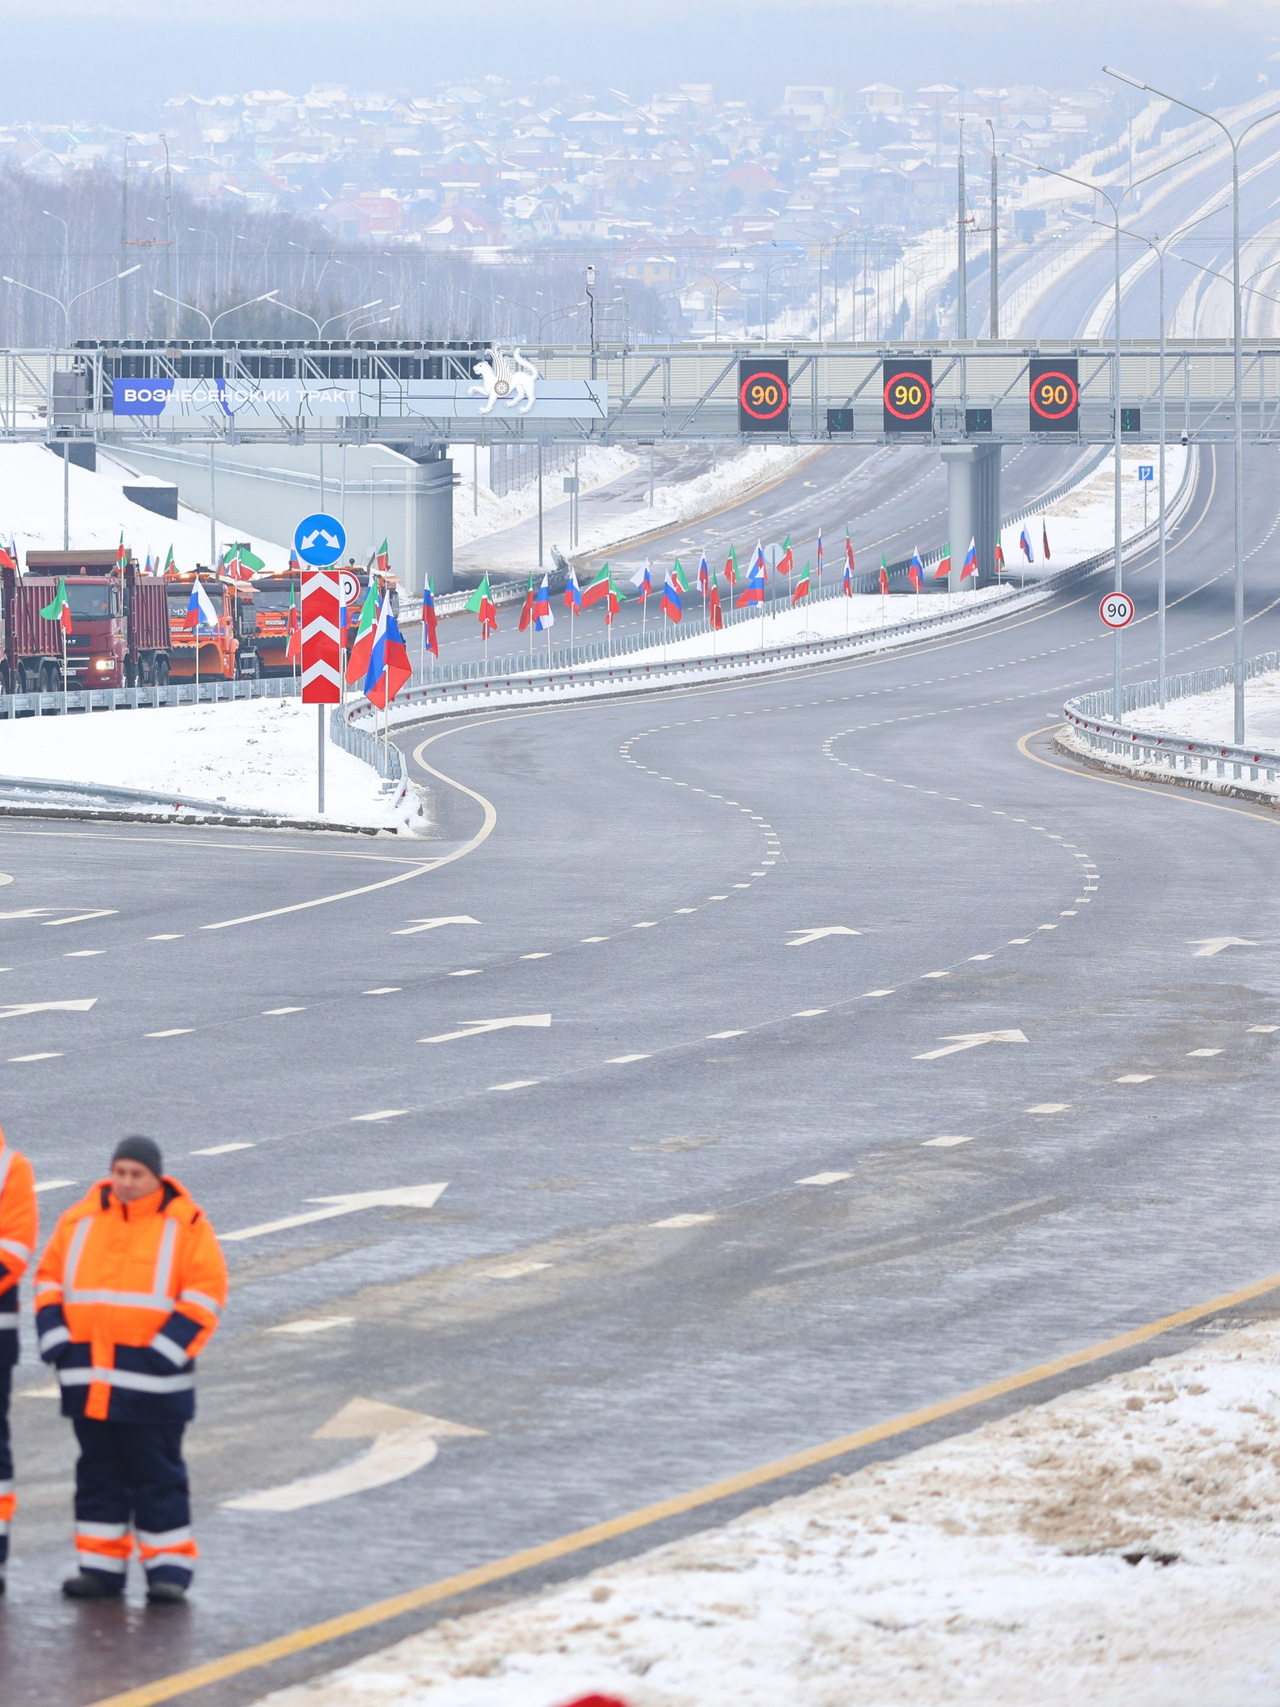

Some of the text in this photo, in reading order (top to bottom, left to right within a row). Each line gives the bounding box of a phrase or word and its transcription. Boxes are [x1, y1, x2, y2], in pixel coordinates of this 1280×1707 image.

[124, 387, 358, 402] ВОЗНЕСЕНСКИЙ ТРАКТ
[751, 385, 778, 405] 90
[895, 385, 922, 405] 90
[1041, 385, 1068, 405] 90
[1107, 603, 1127, 617] 90
